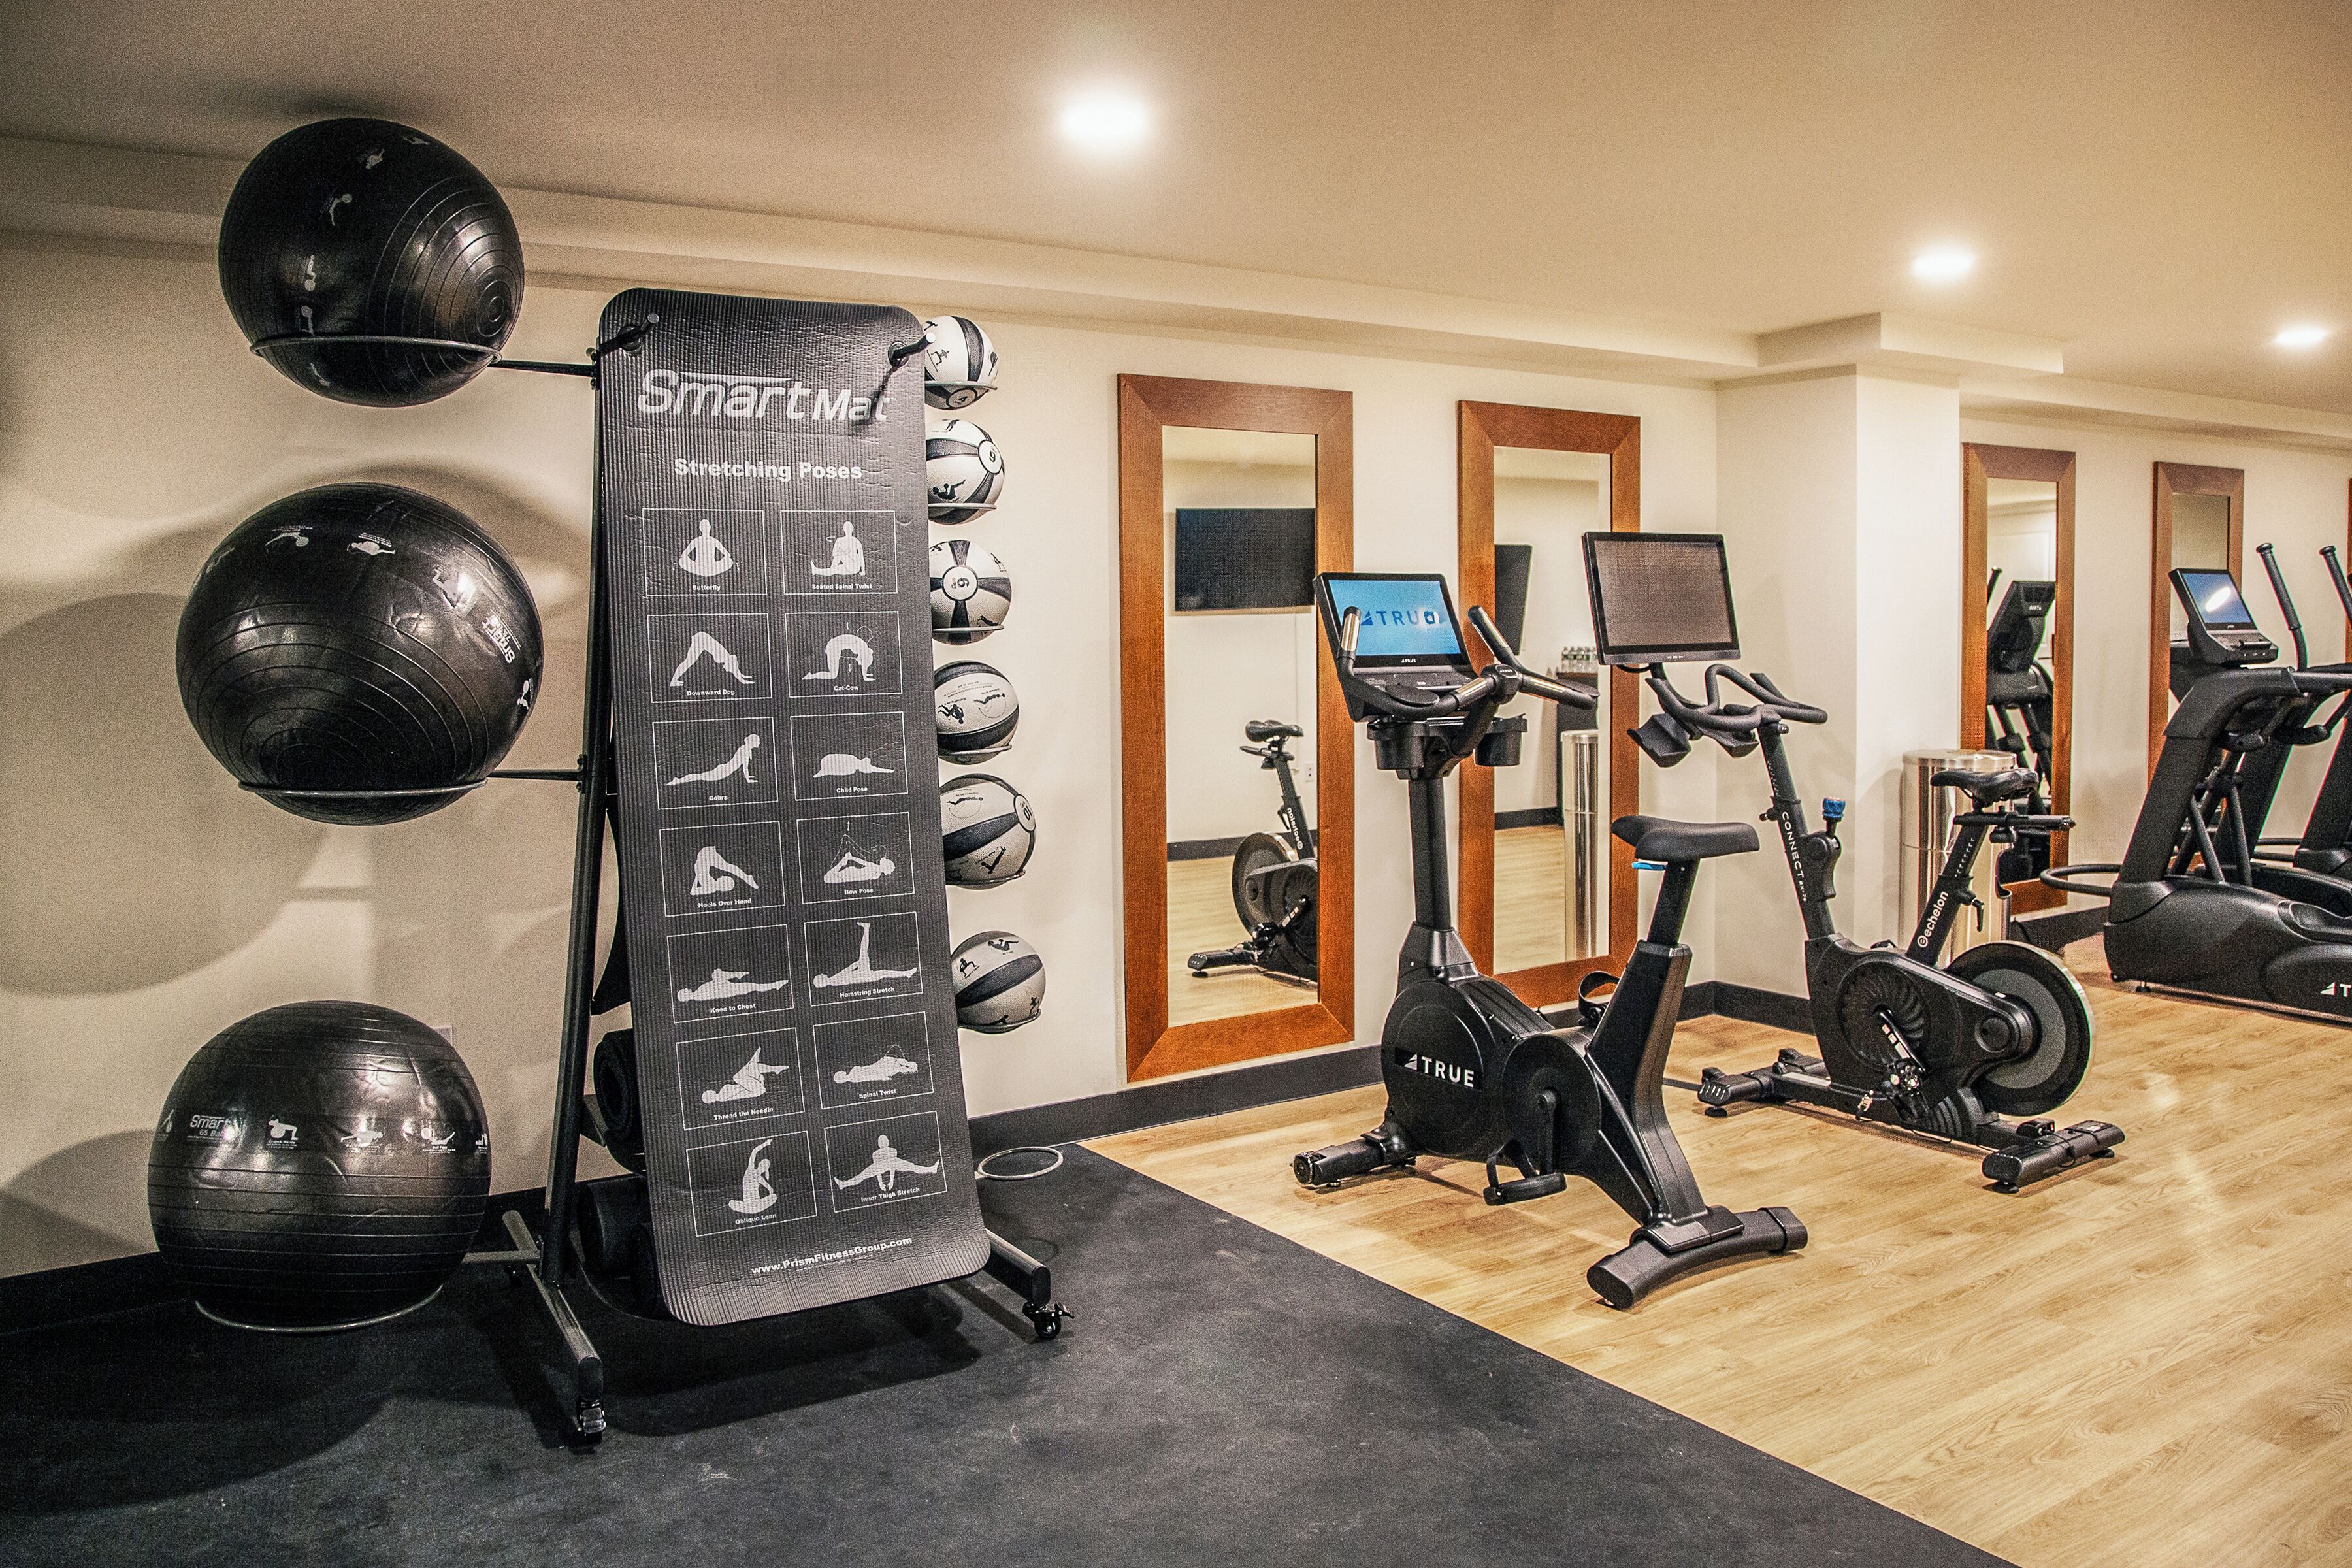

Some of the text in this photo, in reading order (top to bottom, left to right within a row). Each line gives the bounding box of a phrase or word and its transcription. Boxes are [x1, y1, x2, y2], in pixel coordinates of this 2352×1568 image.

[674, 458, 862, 482] Stretching Poses
[1782, 811, 1805, 879] CONNECT
[1924, 891, 1949, 938] echelon
[1421, 1056, 1475, 1088] TRUE
[713, 1111, 738, 1120] Thread
[897, 1186, 921, 1196] Stretch
[735, 1216, 760, 1224] Oblique
[751, 1237, 913, 1275] www.PrismFitnessGroup.com
